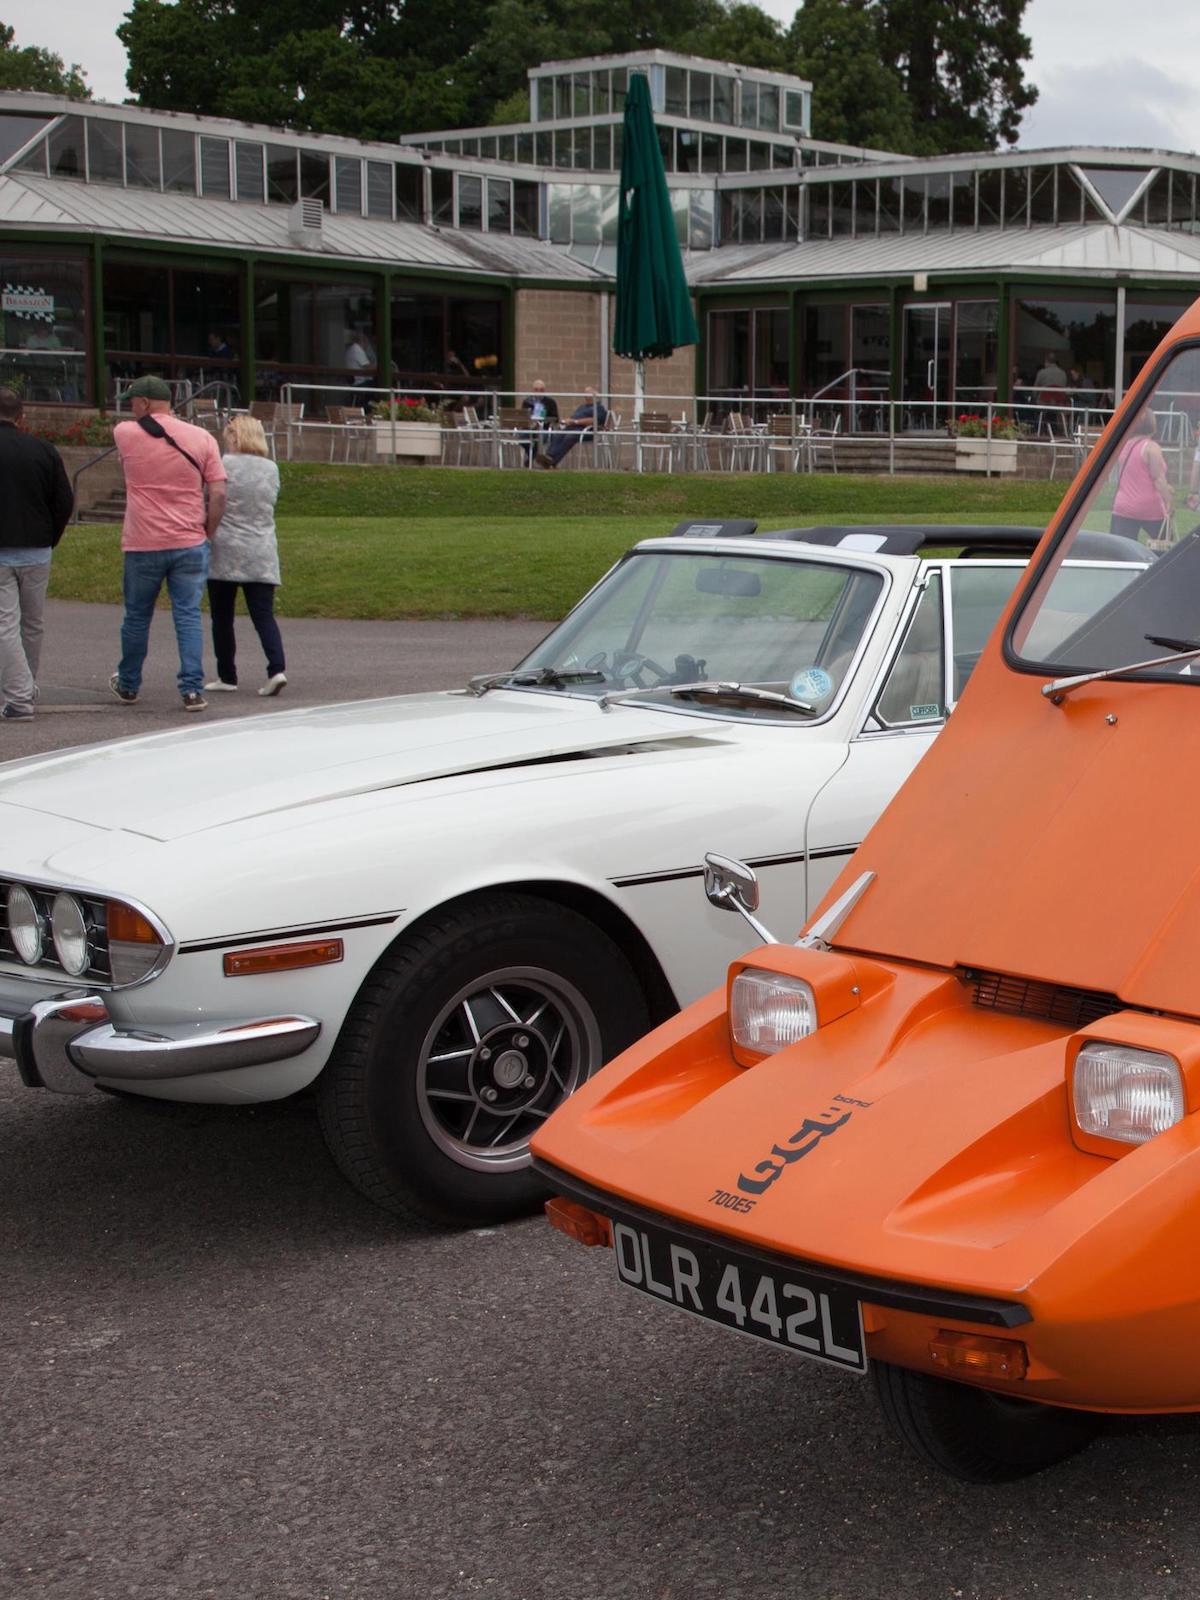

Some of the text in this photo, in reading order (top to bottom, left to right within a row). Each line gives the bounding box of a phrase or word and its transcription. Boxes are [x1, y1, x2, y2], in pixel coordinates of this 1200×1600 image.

[832, 1093, 874, 1109] bond
[708, 1189, 757, 1214] 700ES
[614, 1222, 860, 1365] OLR 442L
